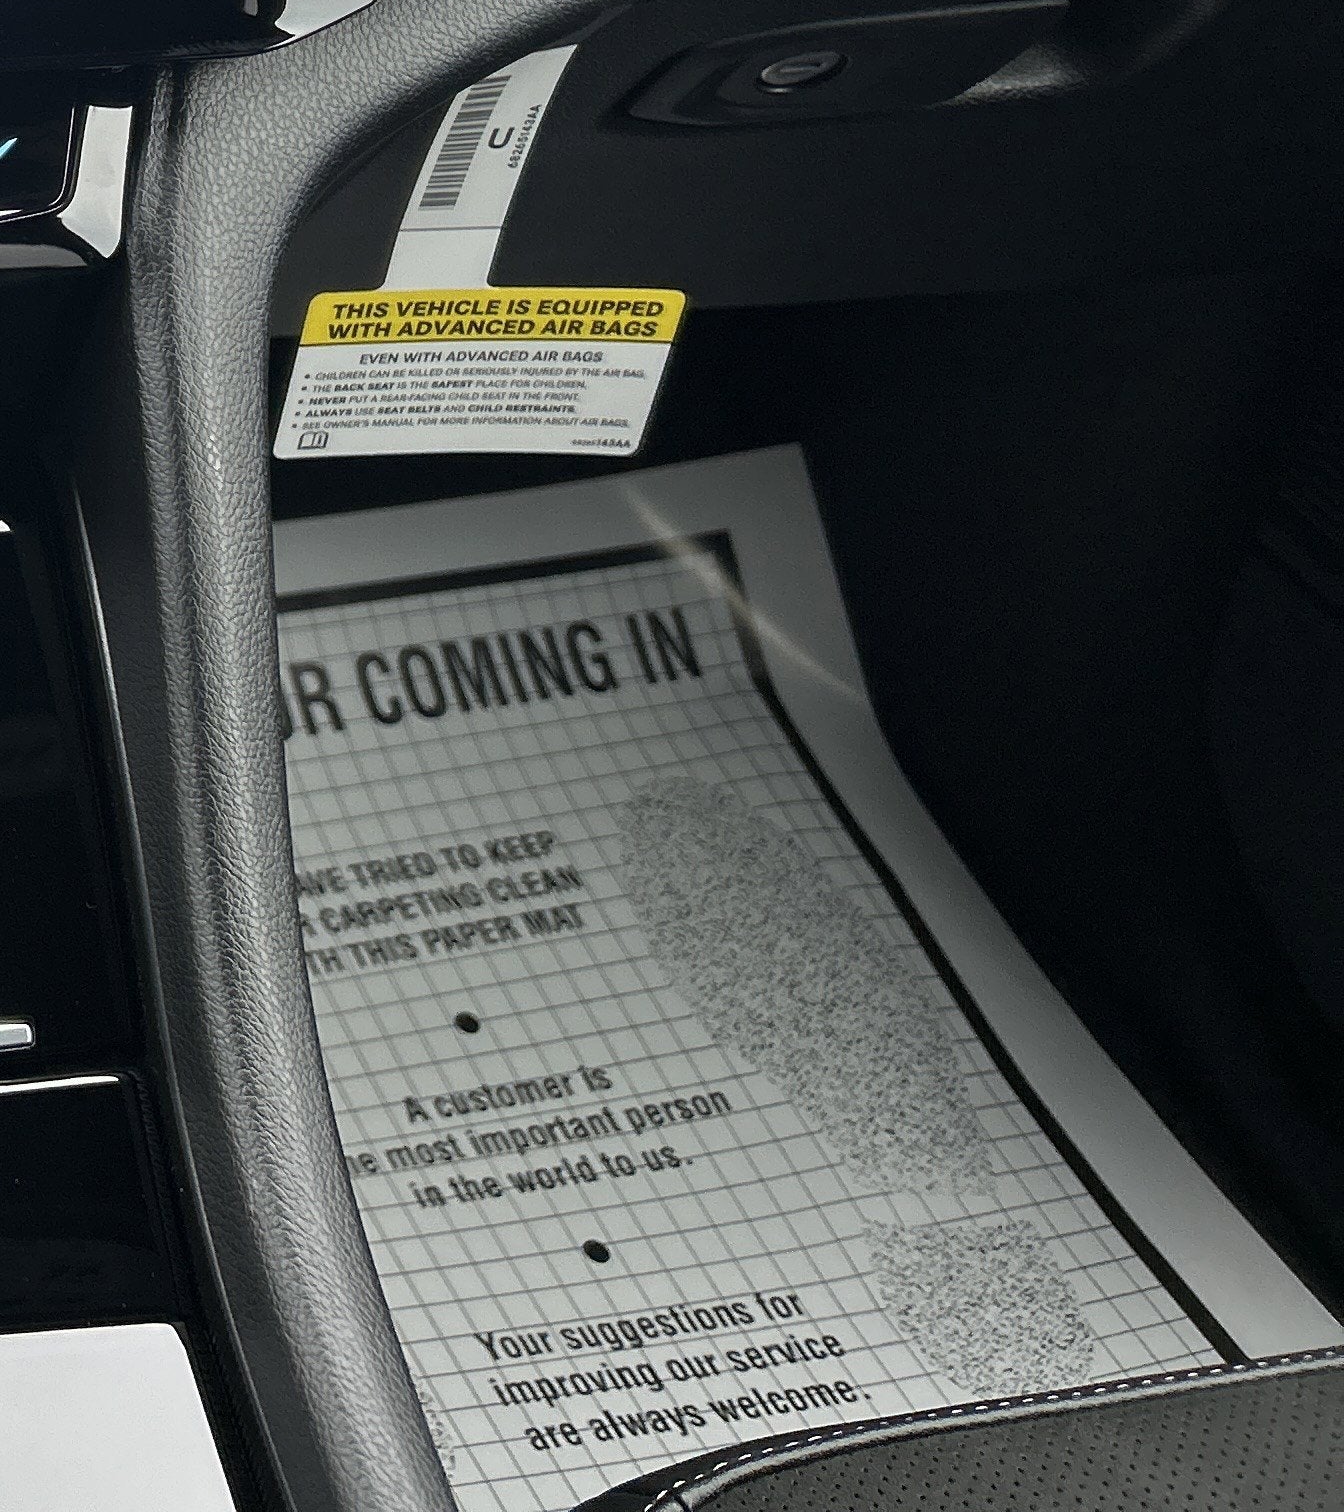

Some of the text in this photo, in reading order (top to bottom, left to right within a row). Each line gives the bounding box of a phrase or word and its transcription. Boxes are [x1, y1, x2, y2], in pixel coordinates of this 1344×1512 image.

[328, 319, 659, 340] WITH ADVANCED AIR BAGS
[333, 299, 664, 320] THIS VEHICLE IS EQUIPPED
[359, 350, 604, 365] EVEN WITH ADVANCED AIR BAGS
[279, 605, 703, 740] R COMING IN
[348, 850, 438, 888] TRIED
[439, 842, 483, 874] TO
[483, 829, 557, 865] KEEP
[318, 880, 485, 935] CARPETING
[485, 863, 585, 904] CLEAN
[345, 932, 418, 971] THIS
[419, 914, 523, 957] PAPER
[521, 902, 587, 937] MAT
[403, 1063, 613, 1126] A customer is
[385, 1088, 733, 1172] most important person
[410, 1144, 694, 1209] in the world to us.
[475, 1289, 806, 1365] Your suggestions for
[489, 1333, 848, 1411] improving our service
[524, 1375, 873, 1453] are always welcome.
